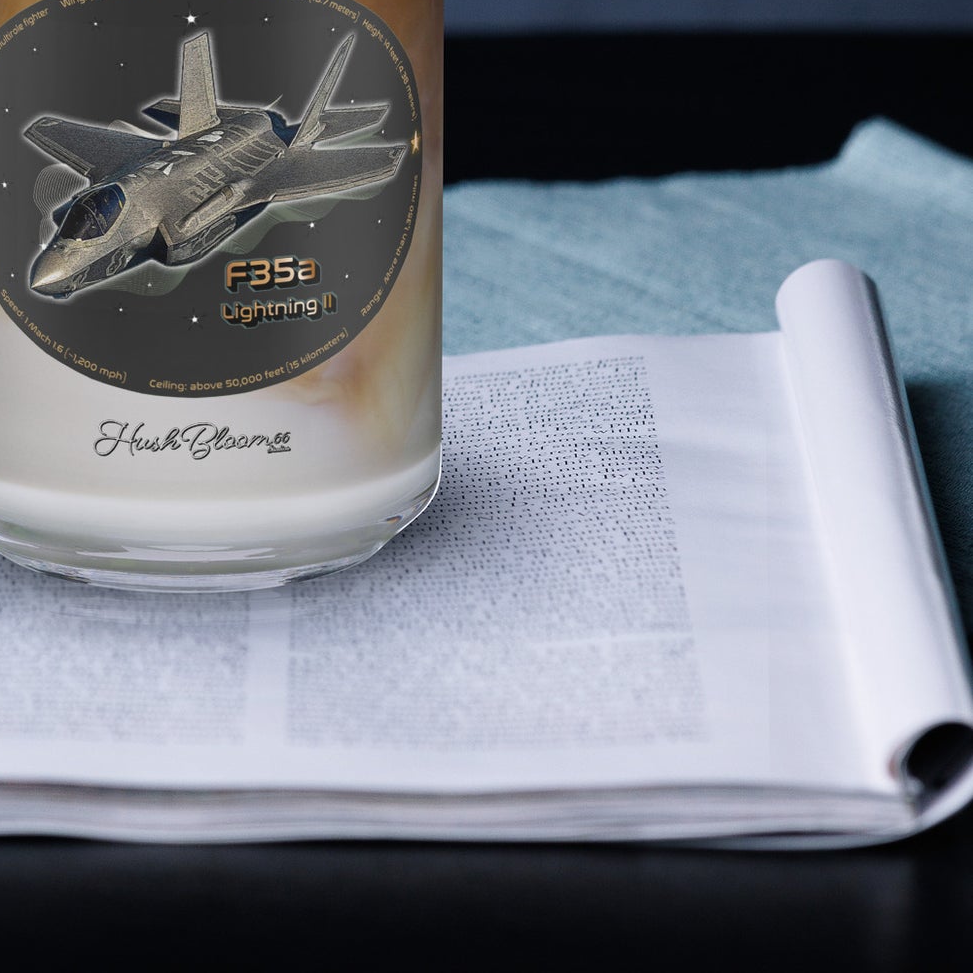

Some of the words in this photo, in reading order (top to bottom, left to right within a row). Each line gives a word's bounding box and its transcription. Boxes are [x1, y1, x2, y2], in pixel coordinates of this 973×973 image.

[23, 8, 49, 27] fighter
[330, 1, 361, 23] meters)
[226, 257, 318, 290] F35a
[383, 257, 398, 285] More
[395, 233, 408, 256] than
[221, 297, 319, 326] Lightning
[28, 322, 52, 346] Mach
[52, 340, 65, 353] 1.6
[99, 367, 127, 384] mph)
[149, 379, 187, 393] Ceiling:
[189, 380, 223, 391] above
[225, 374, 263, 389] 50,000
[264, 366, 285, 379] feet
[285, 360, 300, 374] (15
[300, 327, 349, 365] kilometers)
